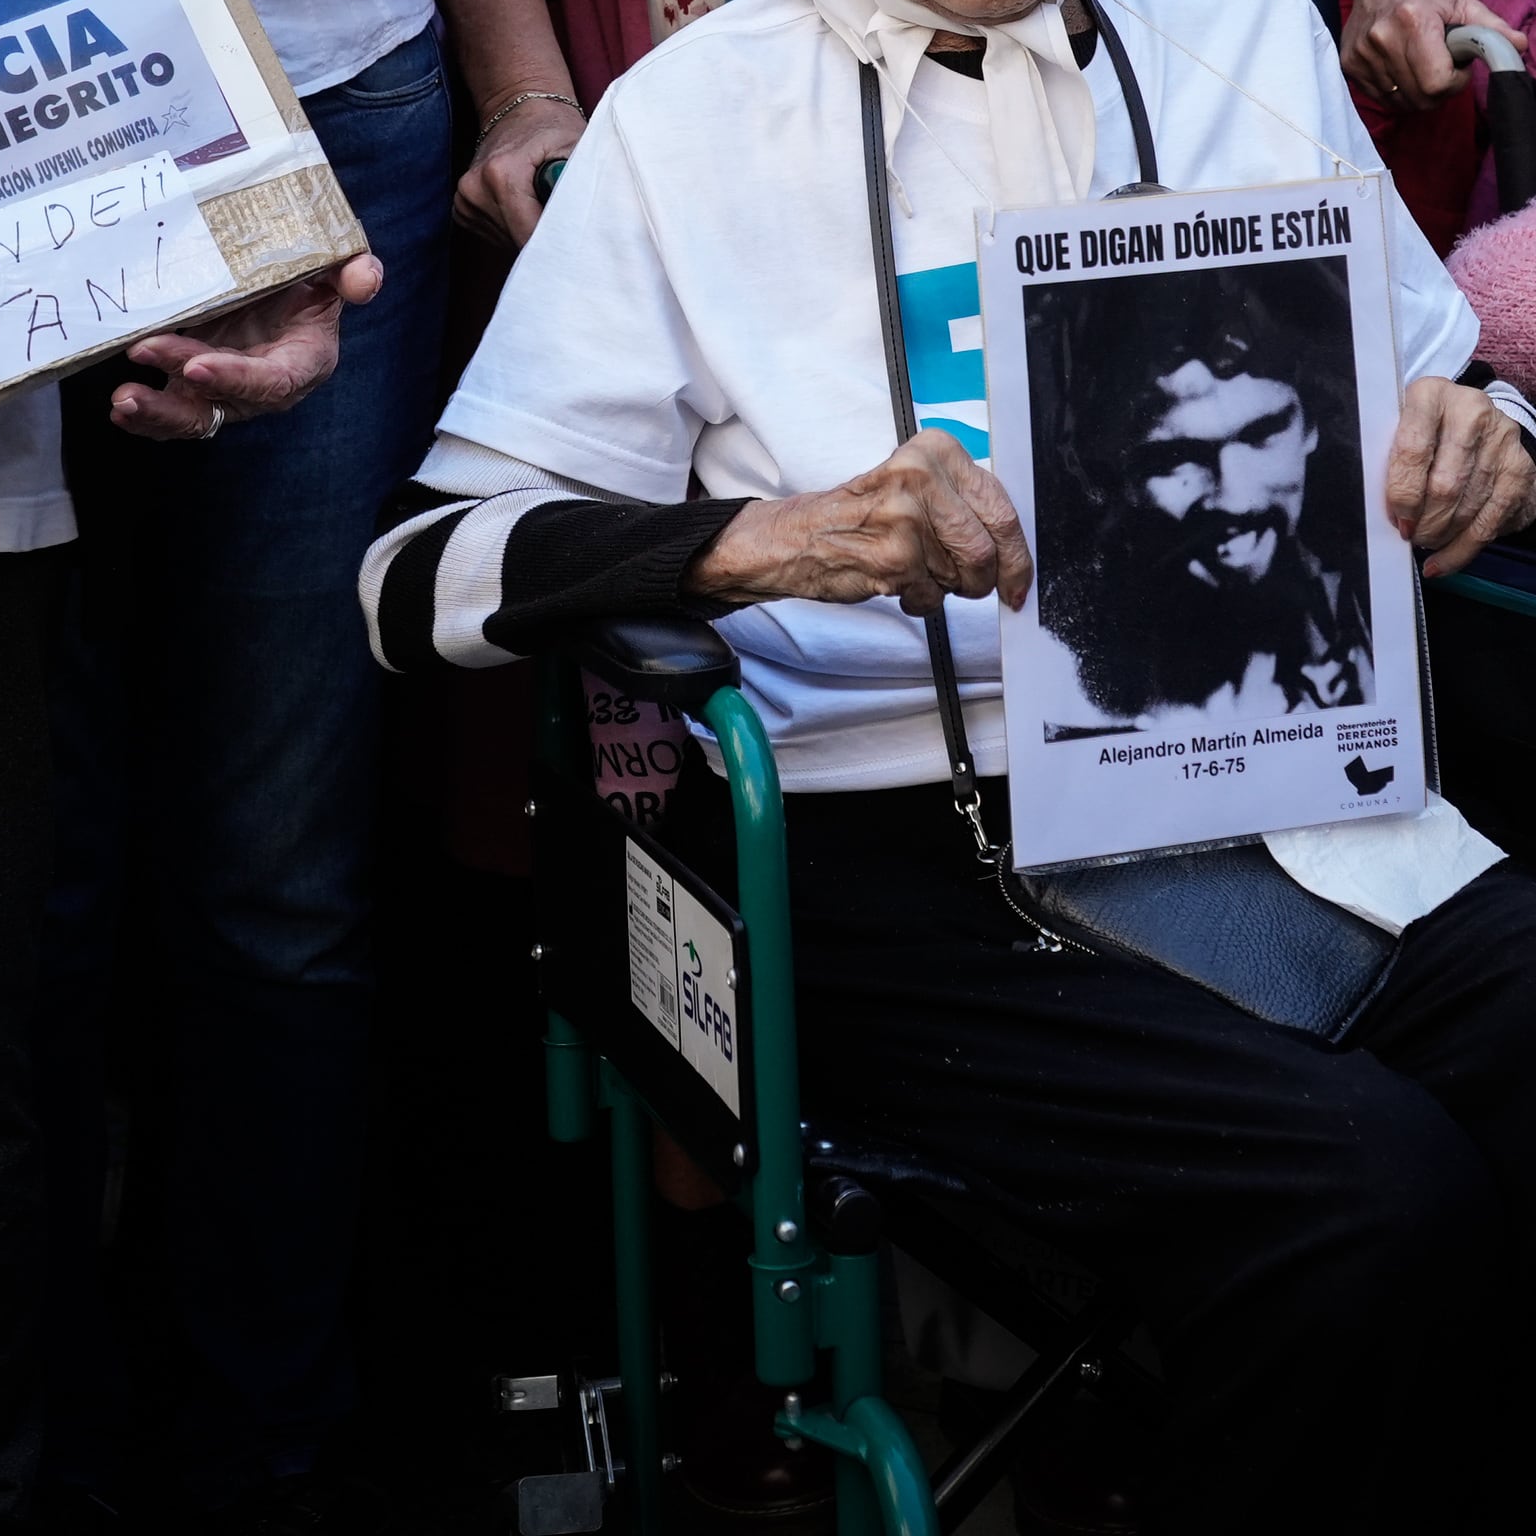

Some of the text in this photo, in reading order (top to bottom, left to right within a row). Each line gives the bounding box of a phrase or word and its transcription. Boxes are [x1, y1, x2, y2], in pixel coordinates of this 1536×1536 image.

[36, 147, 88, 186] JUVENIL
[87, 116, 160, 161] COMUNISTA
[1015, 199, 1352, 276] QUE DIGAN DÓNDE ESTÁN
[1336, 718, 1397, 731] Observatorio de
[1337, 726, 1398, 741] DERECHOS
[1099, 723, 1324, 766] Alejandro Martín Almeida
[1337, 738, 1399, 753] HUMANOS
[1182, 757, 1246, 780] 17-6-75
[1340, 798, 1389, 810] COMUNA
[683, 970, 733, 1064] SILFAB
